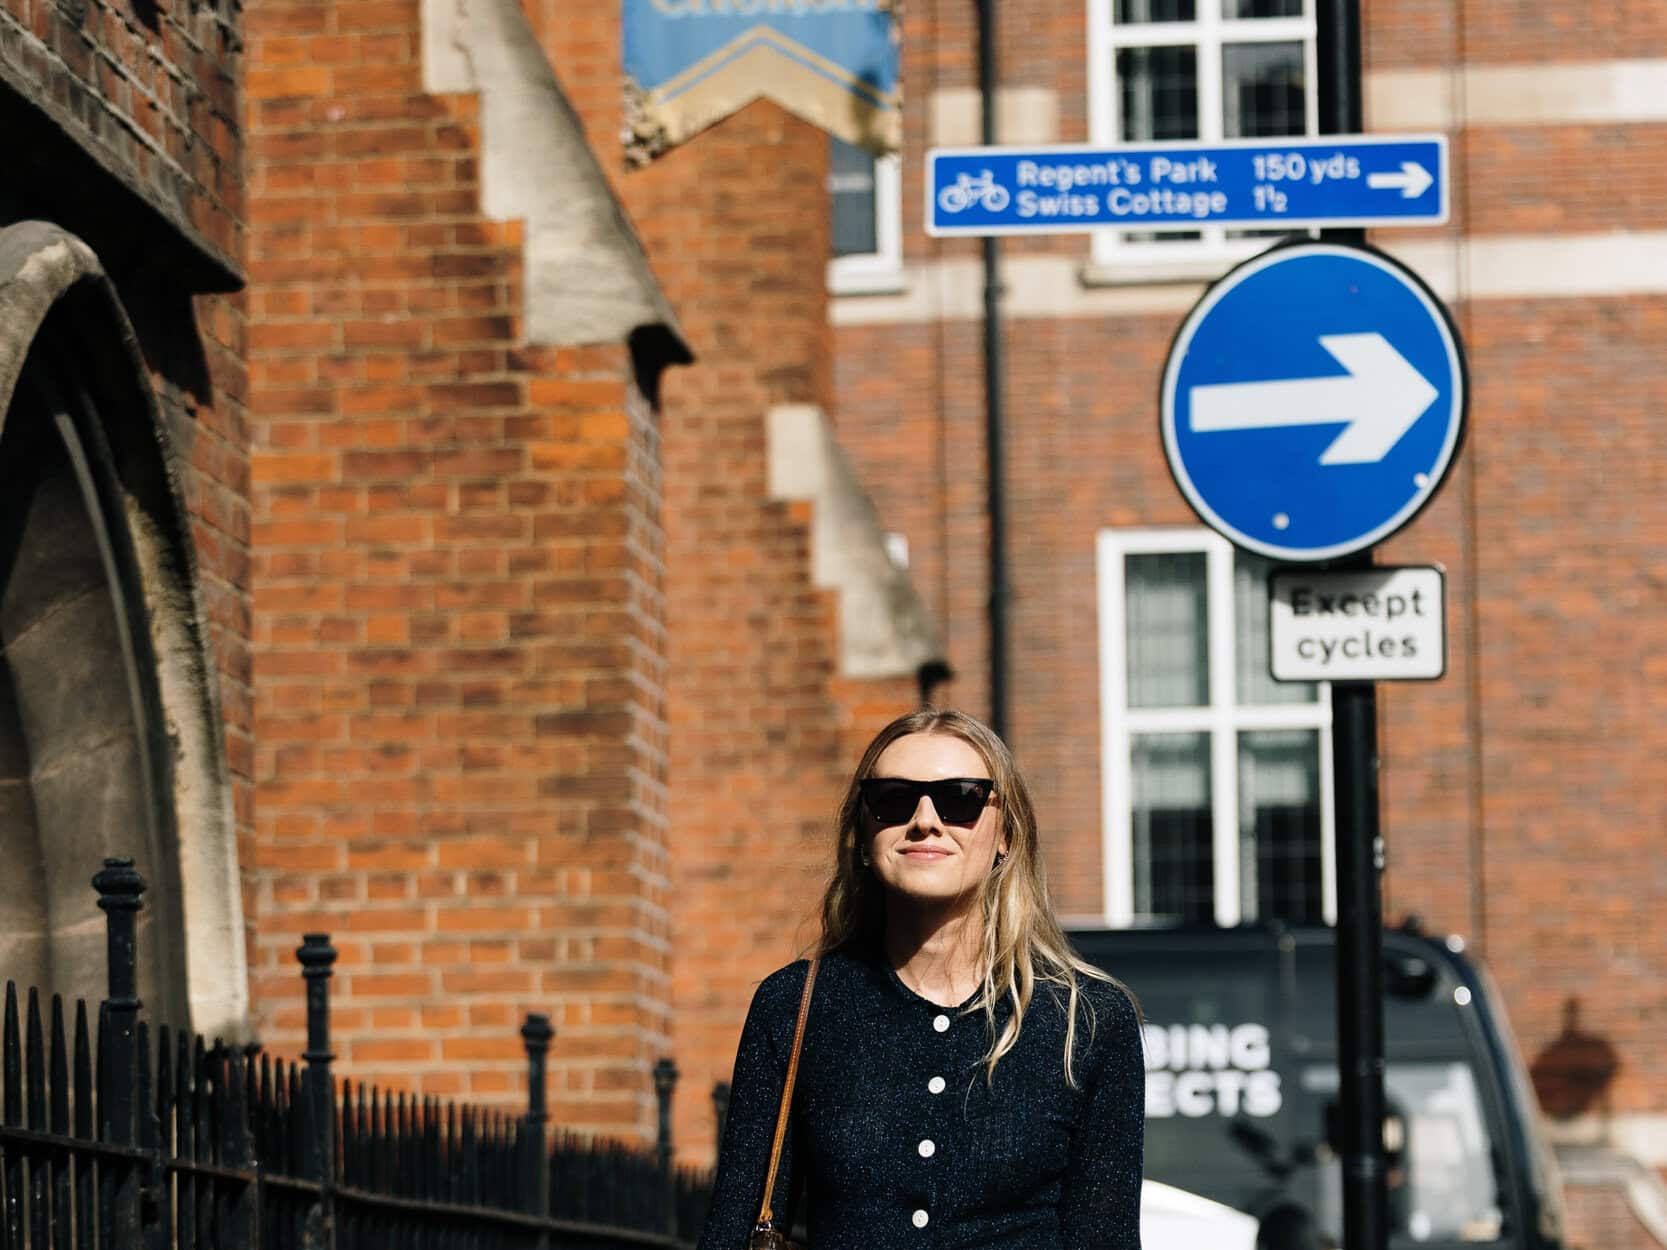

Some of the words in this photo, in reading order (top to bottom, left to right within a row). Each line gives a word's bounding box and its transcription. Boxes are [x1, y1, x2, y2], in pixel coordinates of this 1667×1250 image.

[1017, 159, 1141, 191] Regent's
[1151, 156, 1218, 183] Park
[1253, 152, 1306, 181] 150
[1308, 152, 1361, 185] yds
[1016, 189, 1100, 217] Swiss
[1107, 186, 1228, 218] Cottage
[1291, 587, 1424, 621] Except
[1297, 629, 1418, 665] cycles
